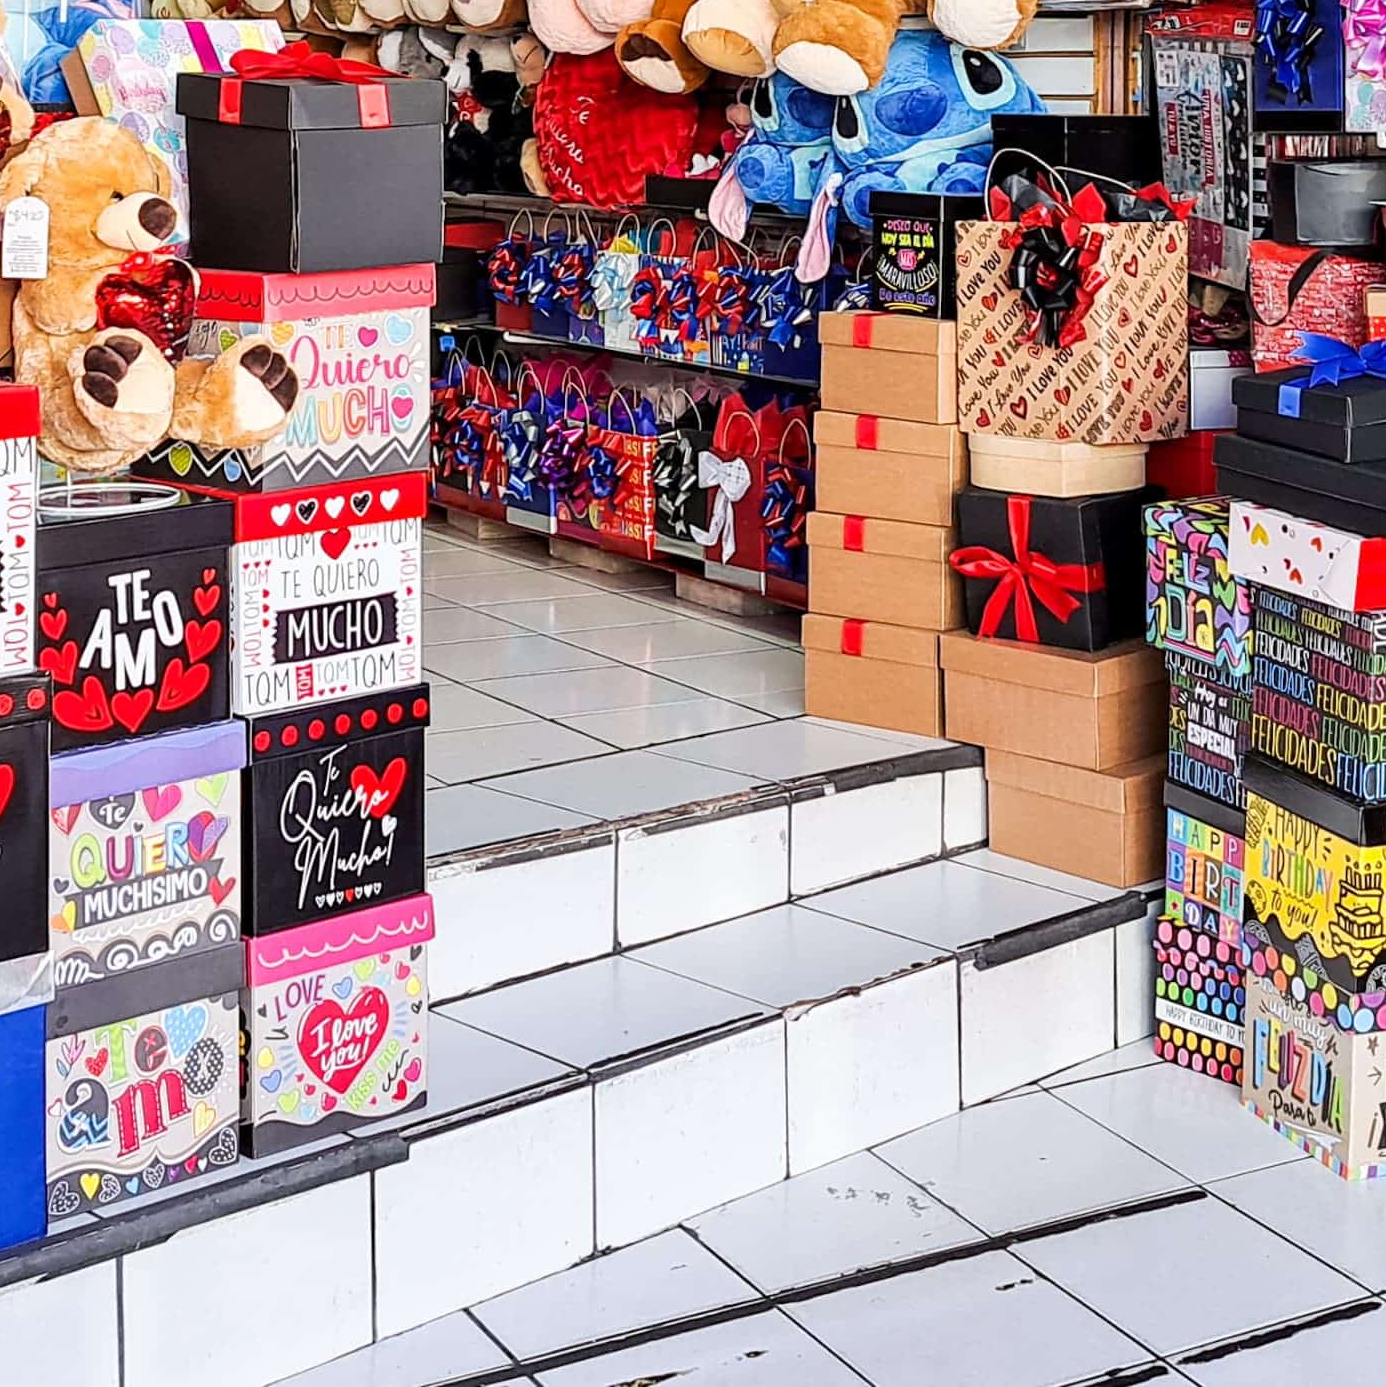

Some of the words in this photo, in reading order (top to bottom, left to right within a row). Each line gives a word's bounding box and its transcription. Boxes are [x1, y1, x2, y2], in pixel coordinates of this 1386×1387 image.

[108, 568, 153, 626] TE
[280, 569, 302, 599] TE
[312, 558, 380, 598] QUIERO
[286, 599, 384, 659] MUCHO
[1253, 657, 1316, 706] FELICIDADES
[1311, 653, 1386, 702] FELICIDADES
[1251, 714, 1337, 786] FELICIDADES
[278, 768, 390, 844] Quiero
[1275, 804, 1321, 860] HAPPY
[1170, 814, 1239, 864] HAPP
[83, 867, 208, 924] MUCHISIMO
[1167, 846, 1241, 911] BIRT
[1262, 839, 1334, 913] BIRTHDAY
[273, 974, 326, 1022] LOVE
[94, 1017, 169, 1084] Te
[332, 1012, 378, 1047] love
